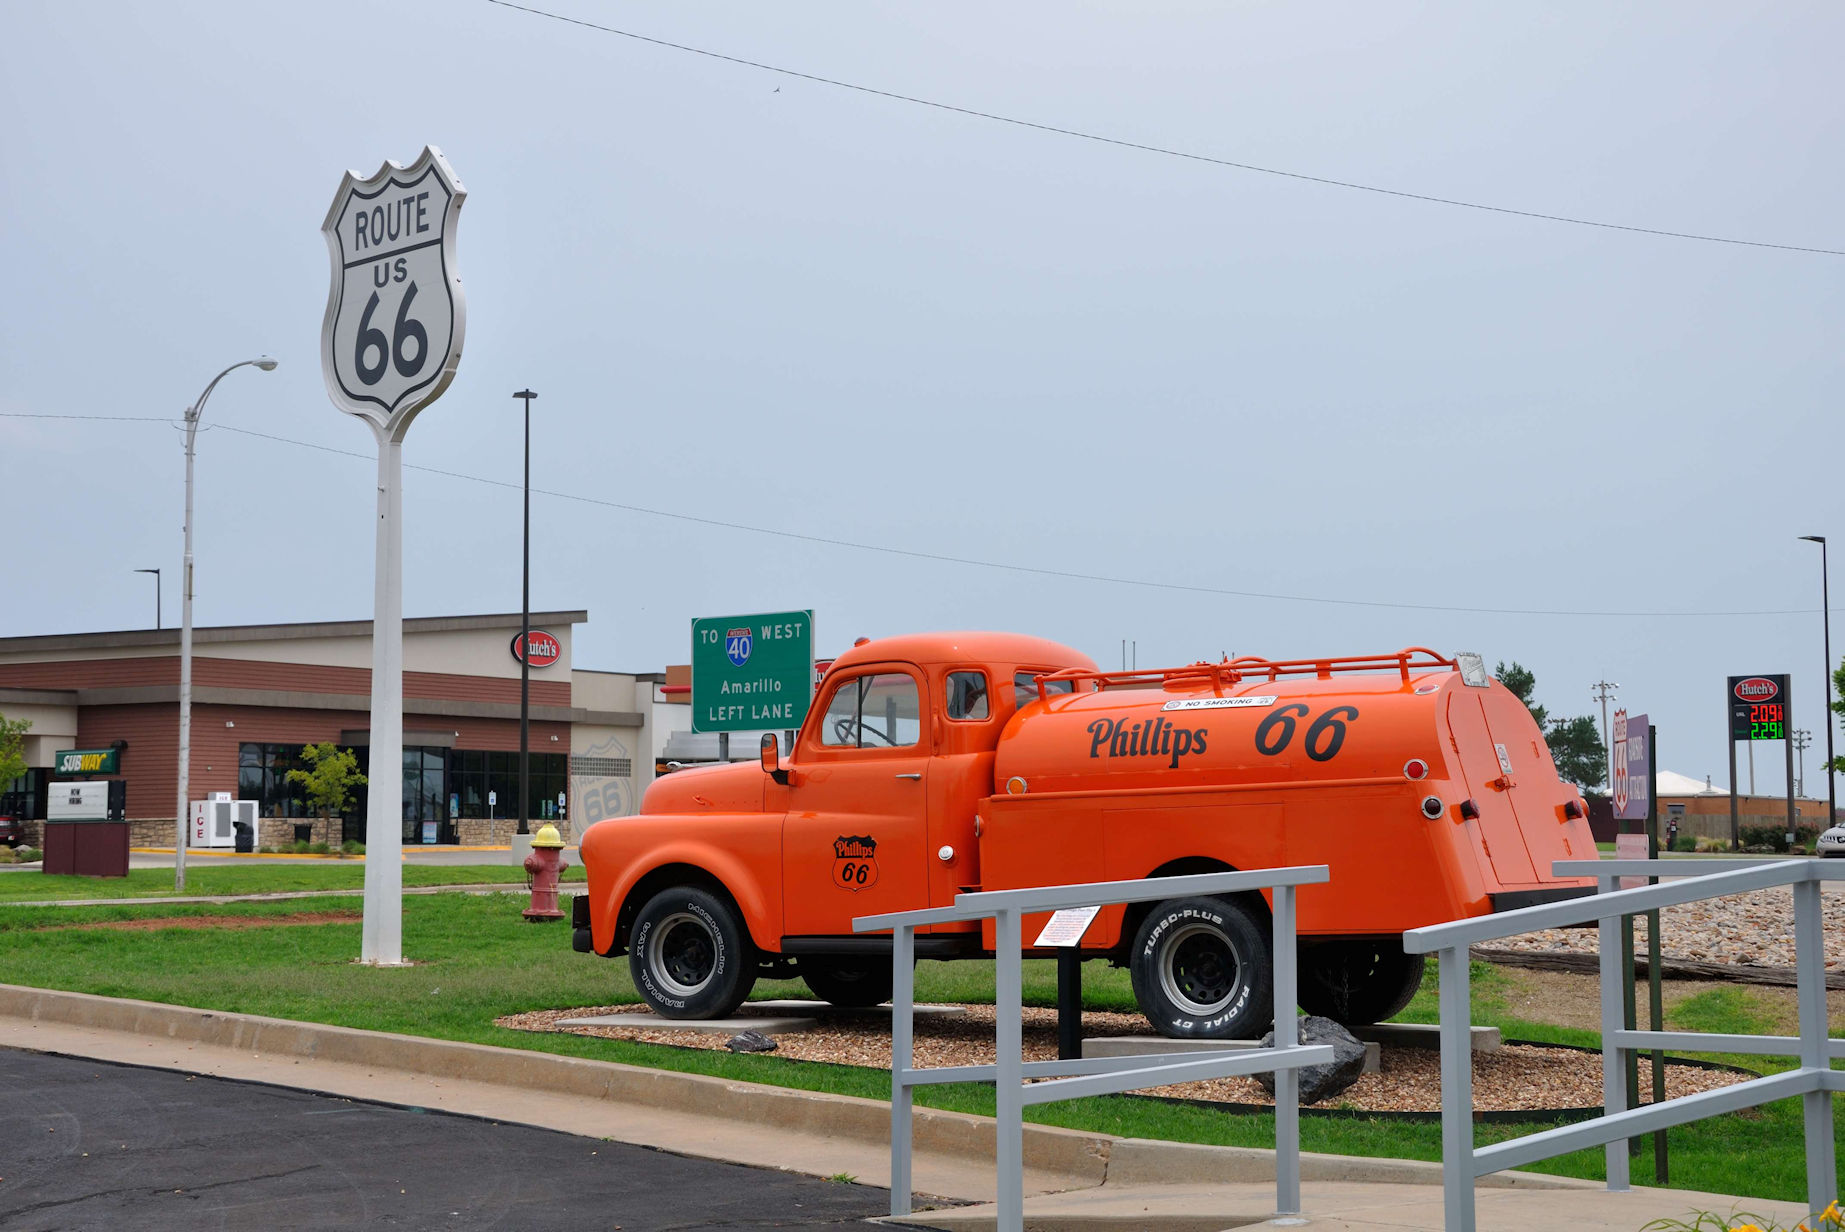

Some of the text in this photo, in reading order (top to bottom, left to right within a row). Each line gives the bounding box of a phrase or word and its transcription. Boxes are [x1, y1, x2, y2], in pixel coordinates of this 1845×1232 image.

[355, 191, 430, 251] ROUTE
[374, 257, 408, 288] US
[354, 280, 428, 386] 66
[527, 638, 557, 657] utch's
[701, 629, 718, 644] TO
[728, 637, 750, 659] 40
[761, 623, 802, 640] WEST
[720, 678, 782, 695] Amarillo
[1741, 682, 1774, 695] Hutch's
[709, 703, 793, 721] LEFT LANE
[1204, 698, 1253, 706] SMOKING
[1751, 705, 1777, 722] 2.09
[1087, 703, 1359, 769] Phillips 66
[1751, 722, 1777, 739] 2.29
[60, 753, 107, 772] SUBWAY
[583, 781, 622, 824] 66
[196, 804, 205, 839] ICE
[836, 840, 873, 860] Phillips
[842, 862, 869, 884] 66
[1144, 910, 1223, 955] TURBO-PLUS
[642, 969, 685, 1008] RADIAL
[1172, 984, 1251, 1030] RADIAL GT
